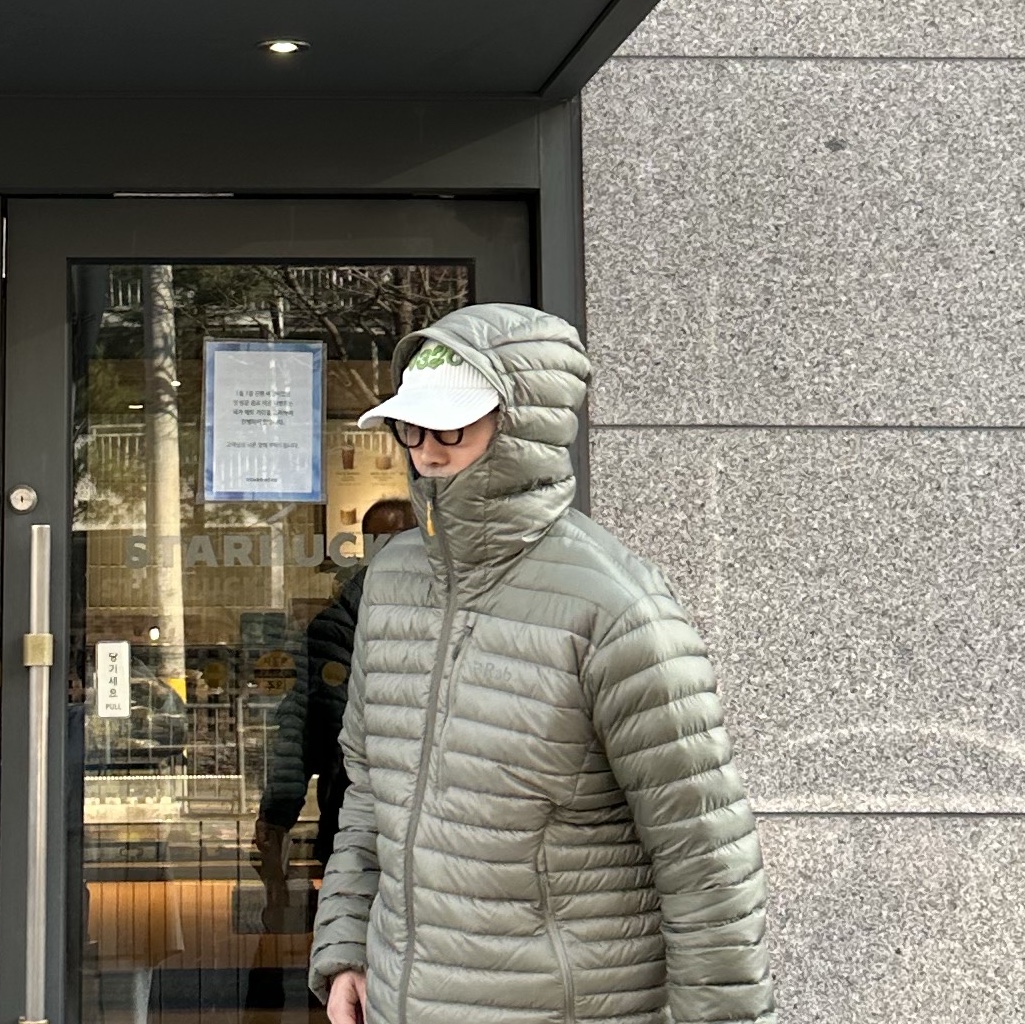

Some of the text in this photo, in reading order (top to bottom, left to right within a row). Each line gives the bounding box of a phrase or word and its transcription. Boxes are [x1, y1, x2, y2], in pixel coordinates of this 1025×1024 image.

[108, 652, 119, 698] 당기세요
[483, 662, 513, 682] Rab
[105, 703, 122, 711] PULL
